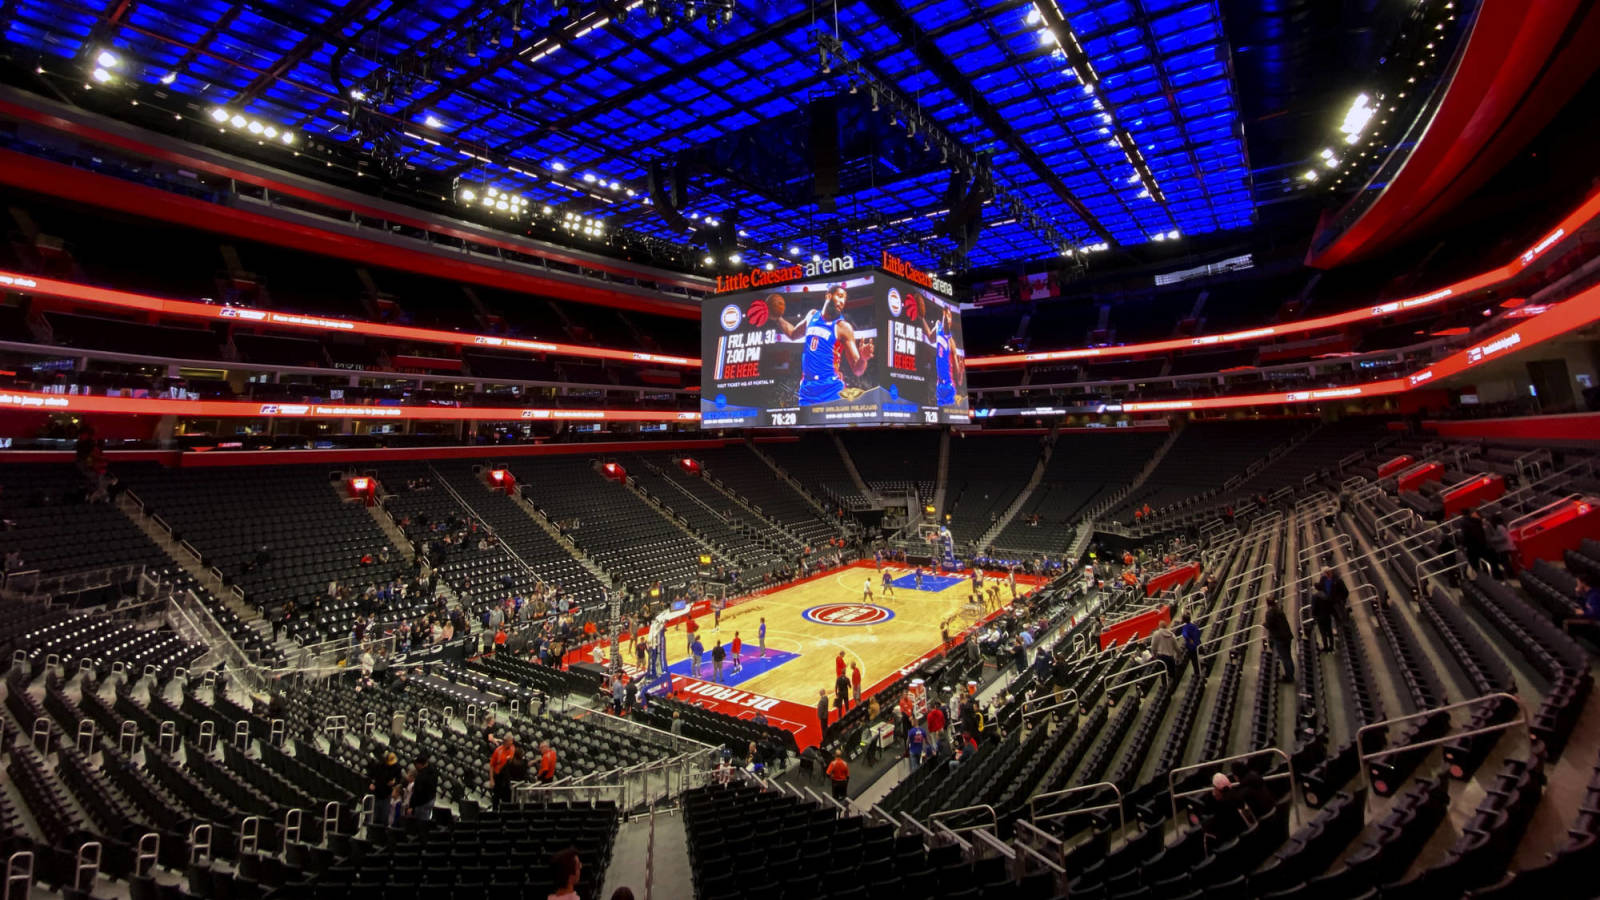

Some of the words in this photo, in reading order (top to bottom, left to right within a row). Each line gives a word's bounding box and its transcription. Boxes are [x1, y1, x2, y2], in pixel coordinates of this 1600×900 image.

[715, 272, 750, 293] Little
[750, 265, 803, 287] Caesars
[805, 255, 854, 277] arena
[882, 250, 905, 277] Little
[904, 261, 933, 288] Caesars
[932, 277, 953, 296] arena
[764, 329, 776, 344] 31
[726, 349, 745, 364] 7:00
[745, 347, 761, 361] PM
[724, 365, 736, 379] BE
[736, 363, 760, 378] HERE.
[683, 681, 782, 712] DETROIT
